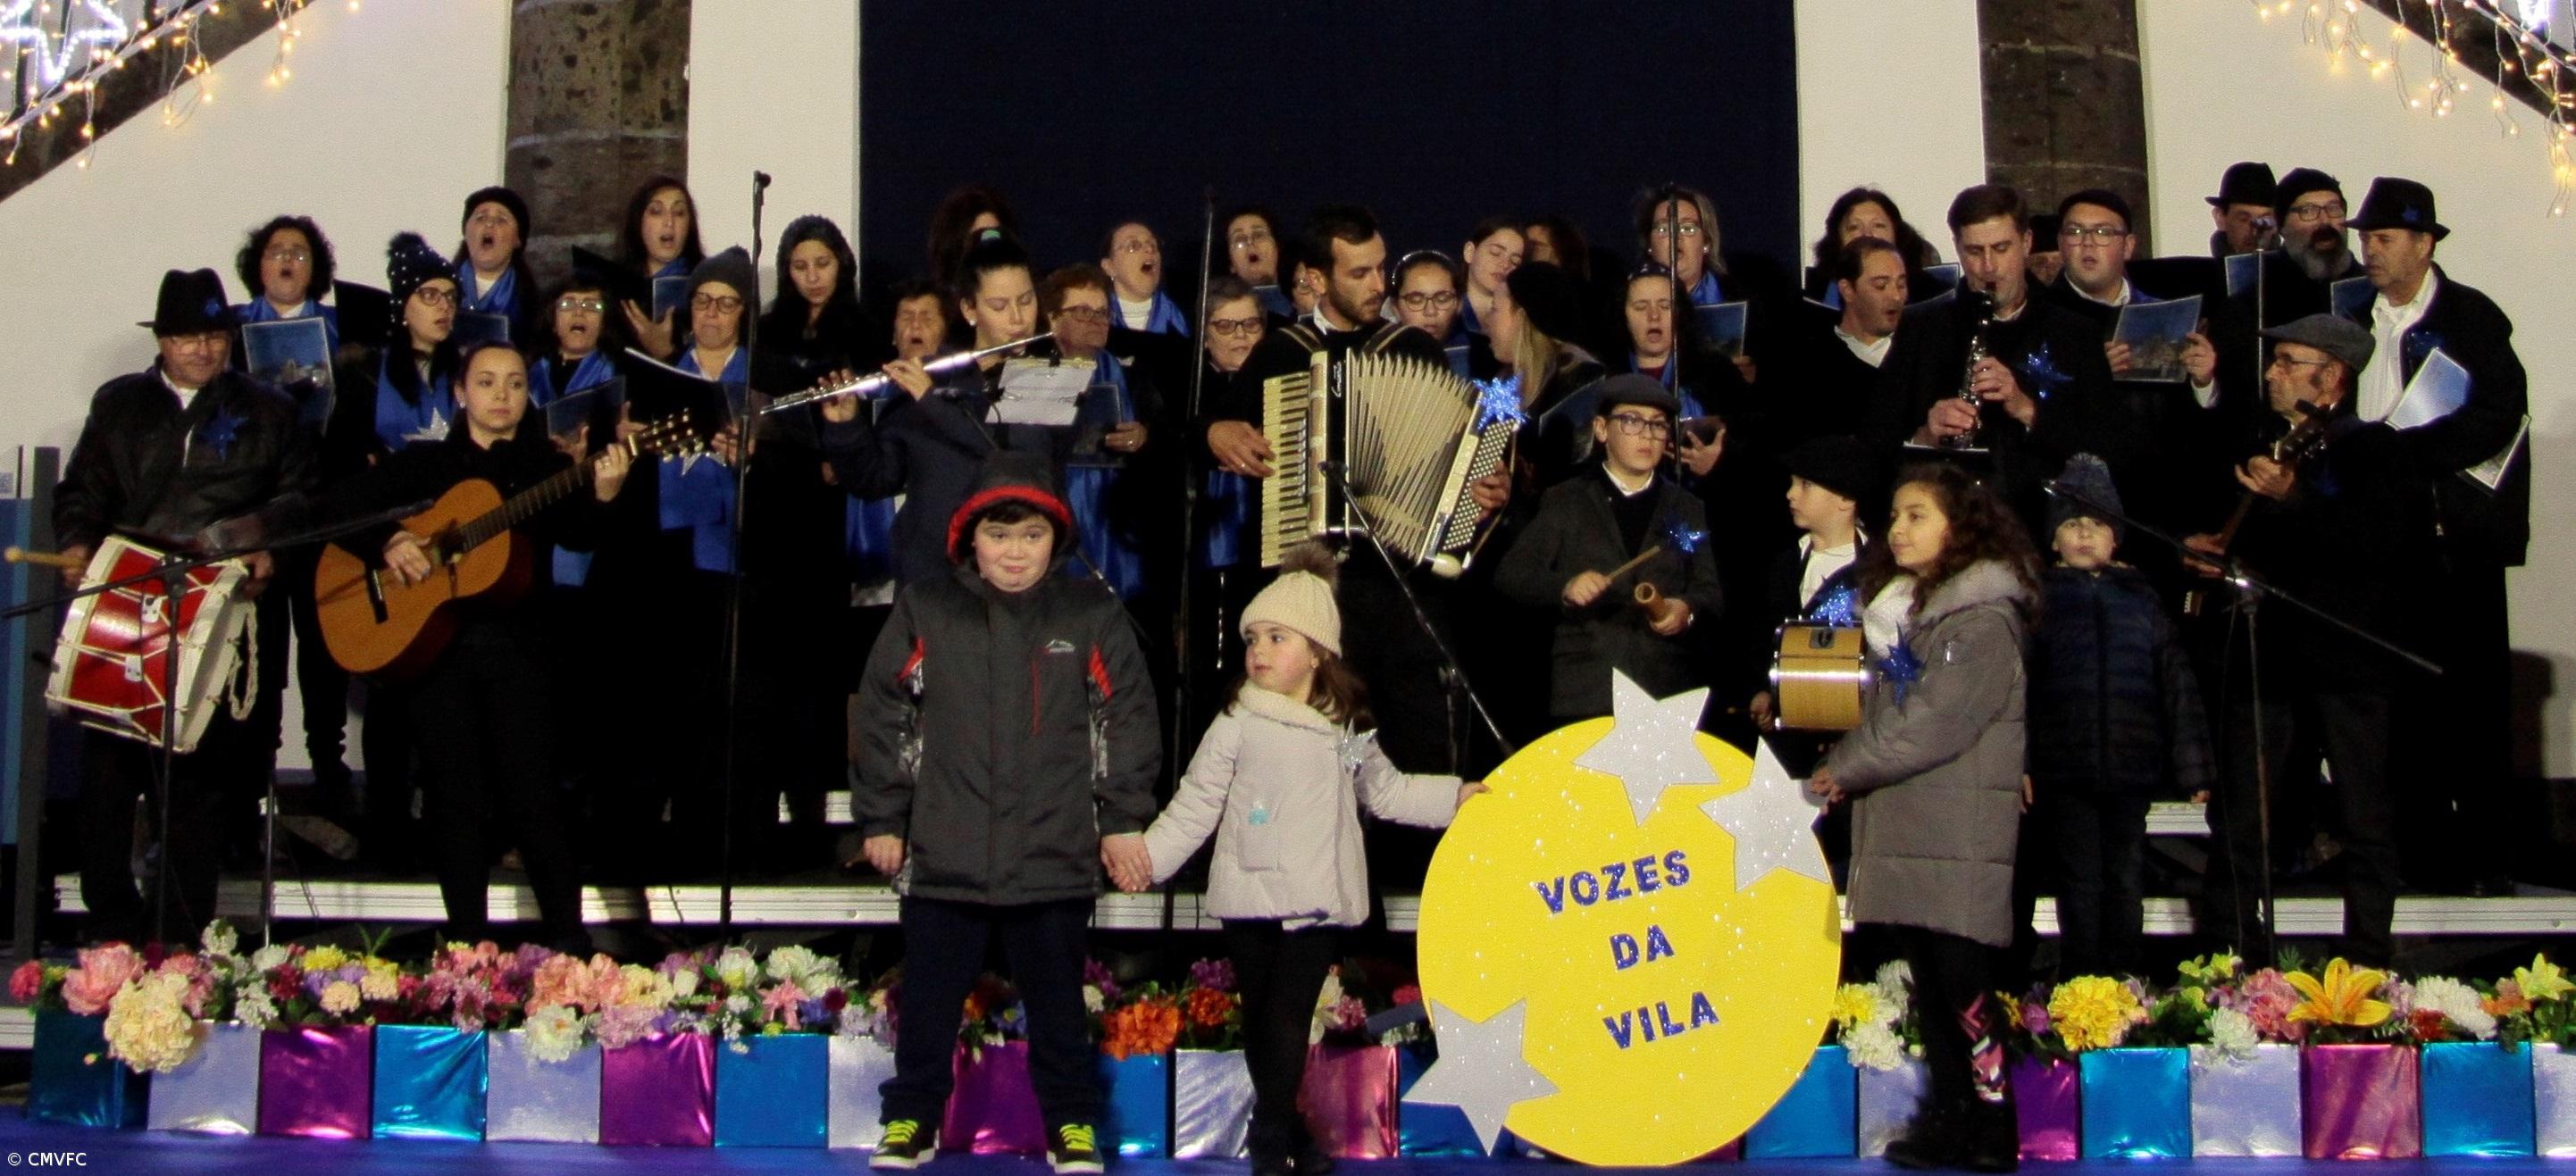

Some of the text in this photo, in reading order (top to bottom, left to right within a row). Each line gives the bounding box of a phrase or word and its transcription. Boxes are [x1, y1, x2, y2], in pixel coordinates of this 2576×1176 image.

[1536, 849, 1690, 913] VOZES
[1610, 924, 1675, 971] DA
[1602, 991, 1719, 1049] VILA
